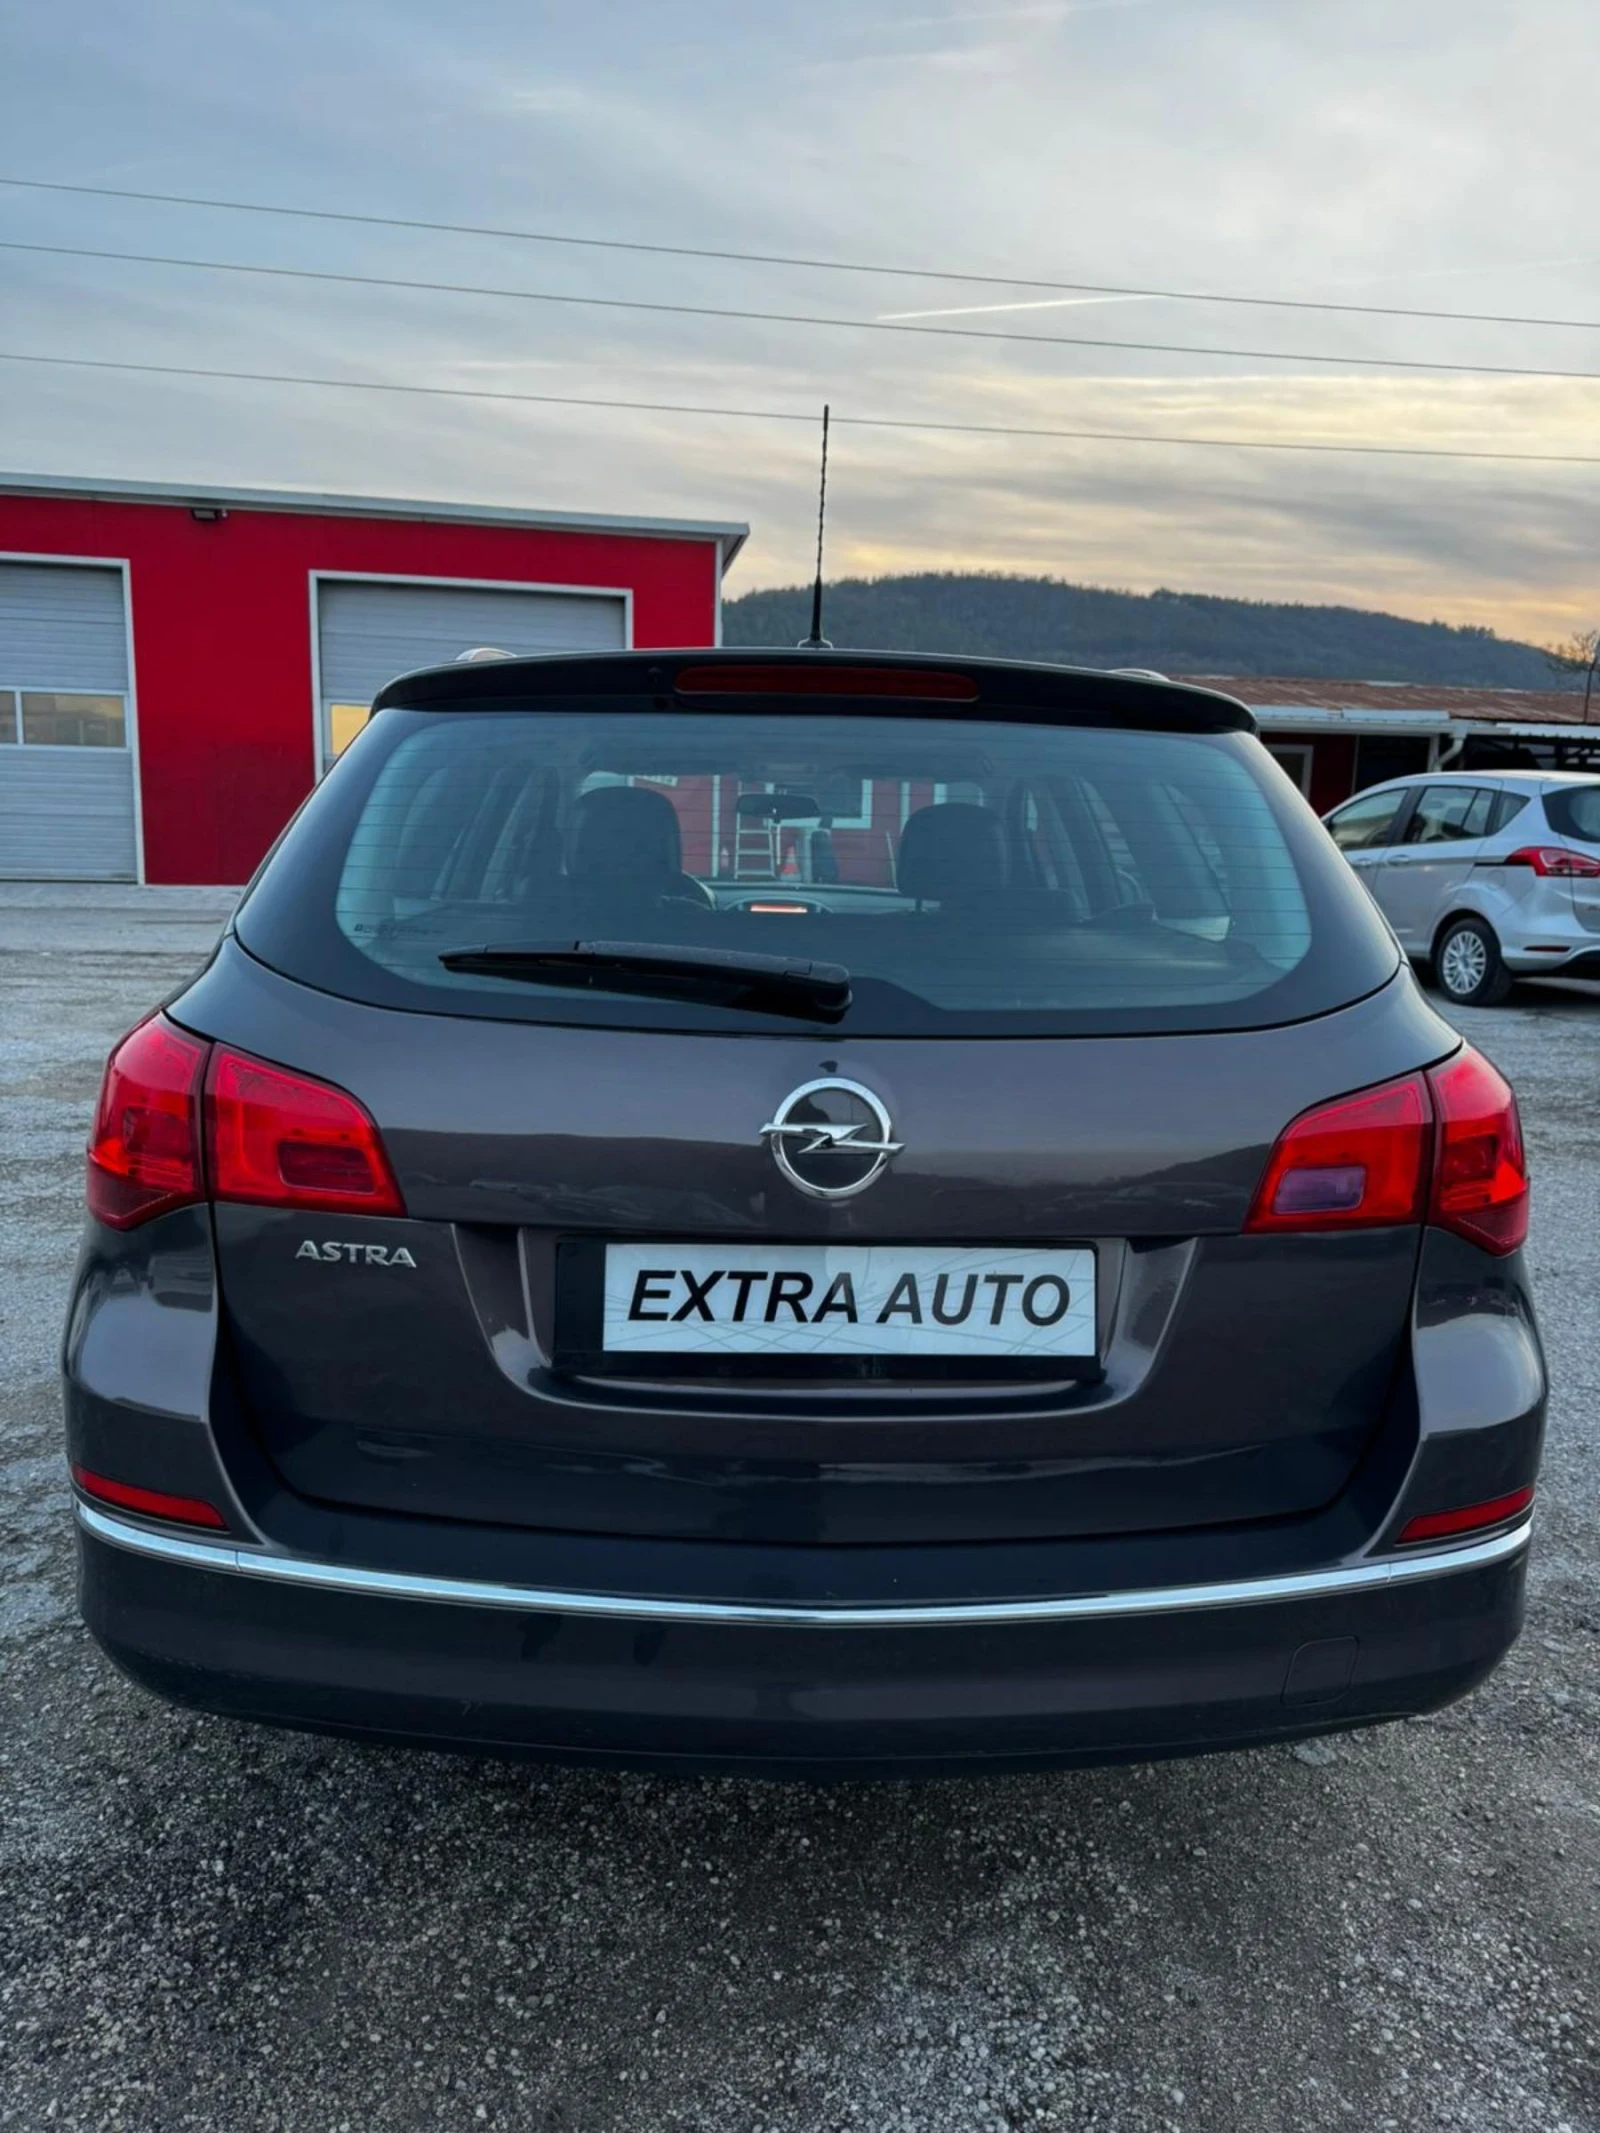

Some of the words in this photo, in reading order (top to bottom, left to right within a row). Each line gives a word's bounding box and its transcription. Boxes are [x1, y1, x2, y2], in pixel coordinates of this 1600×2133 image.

[295, 1240, 416, 1268] ASTRA
[627, 1269, 858, 1324] EXTRA
[876, 1271, 1071, 1327] AUTO
